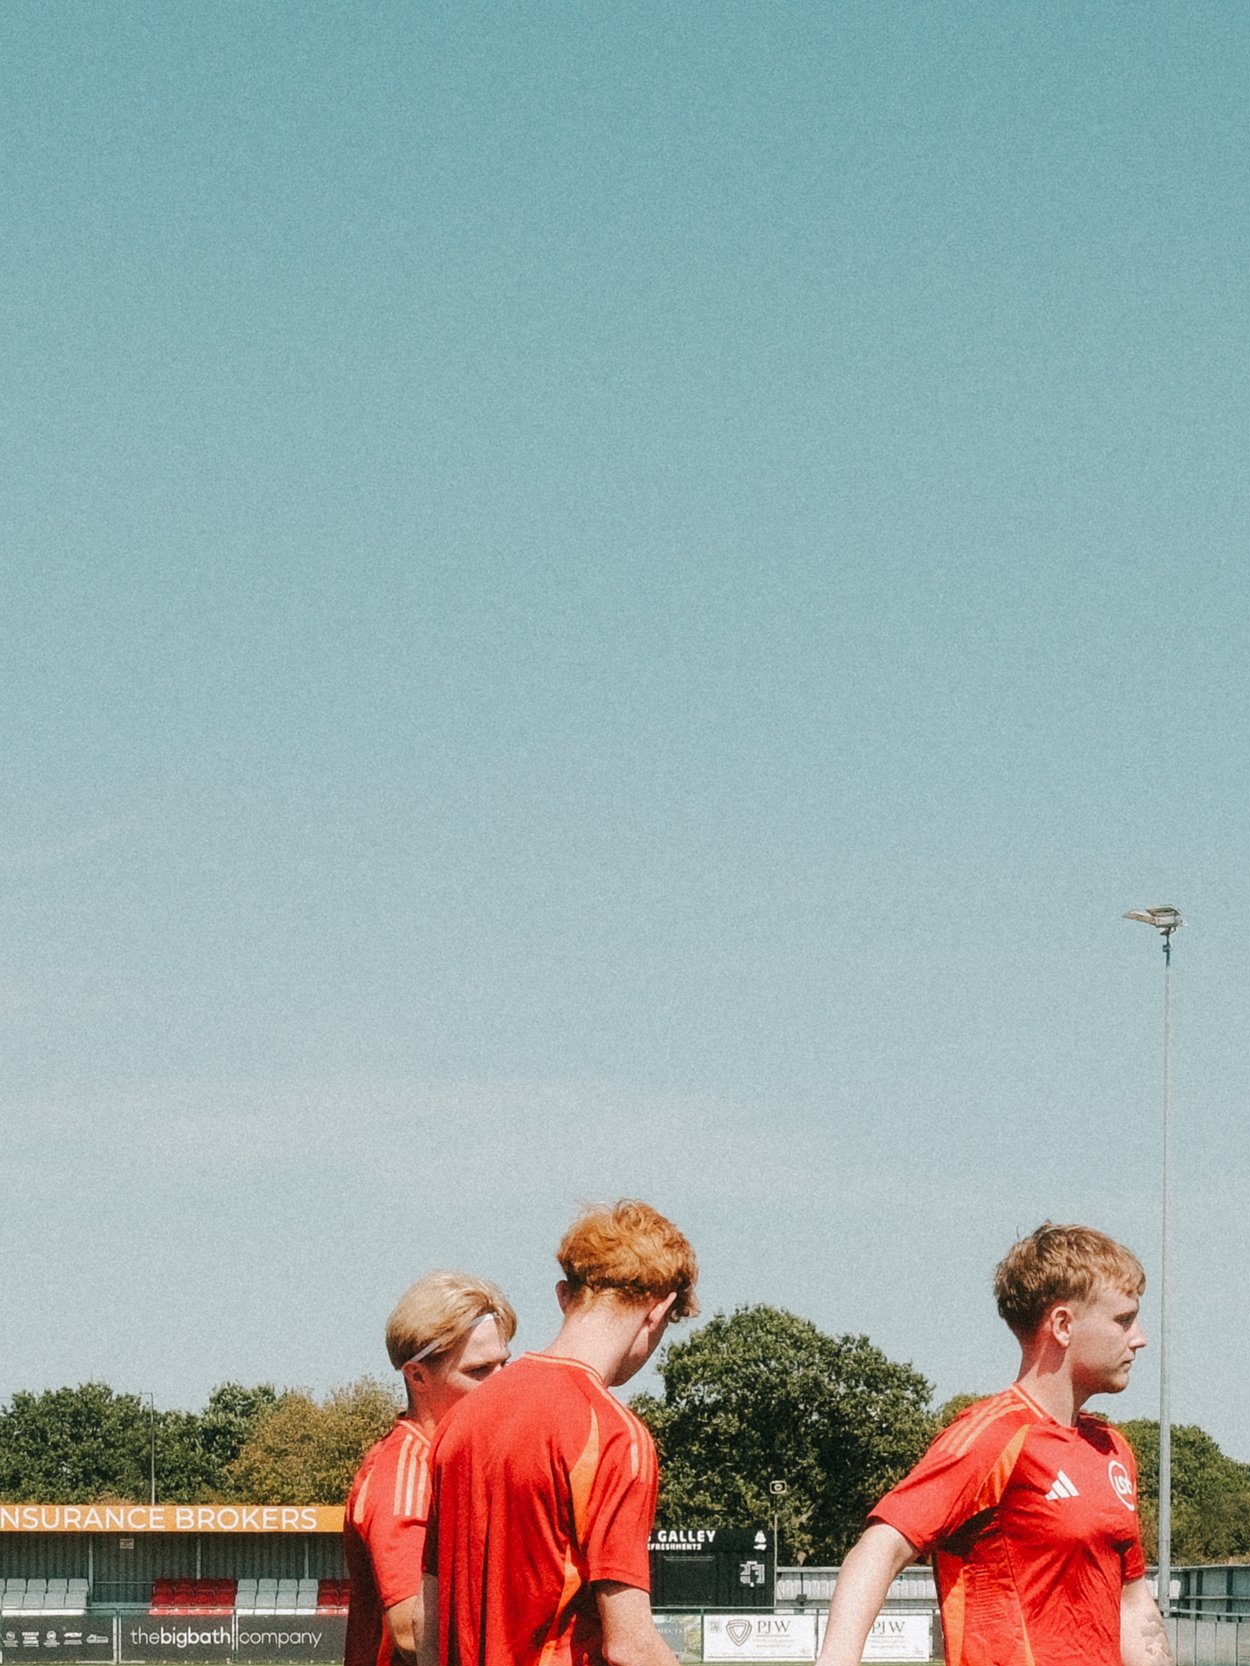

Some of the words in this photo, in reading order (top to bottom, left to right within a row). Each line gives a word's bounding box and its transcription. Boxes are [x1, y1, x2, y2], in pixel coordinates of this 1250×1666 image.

[0, 1507, 165, 1529] NSURANCE
[176, 1507, 317, 1529] BROKERS
[658, 1530, 716, 1543] GALLEY
[647, 1543, 702, 1551] EFRESHMENTS
[757, 1620, 791, 1634] PJW
